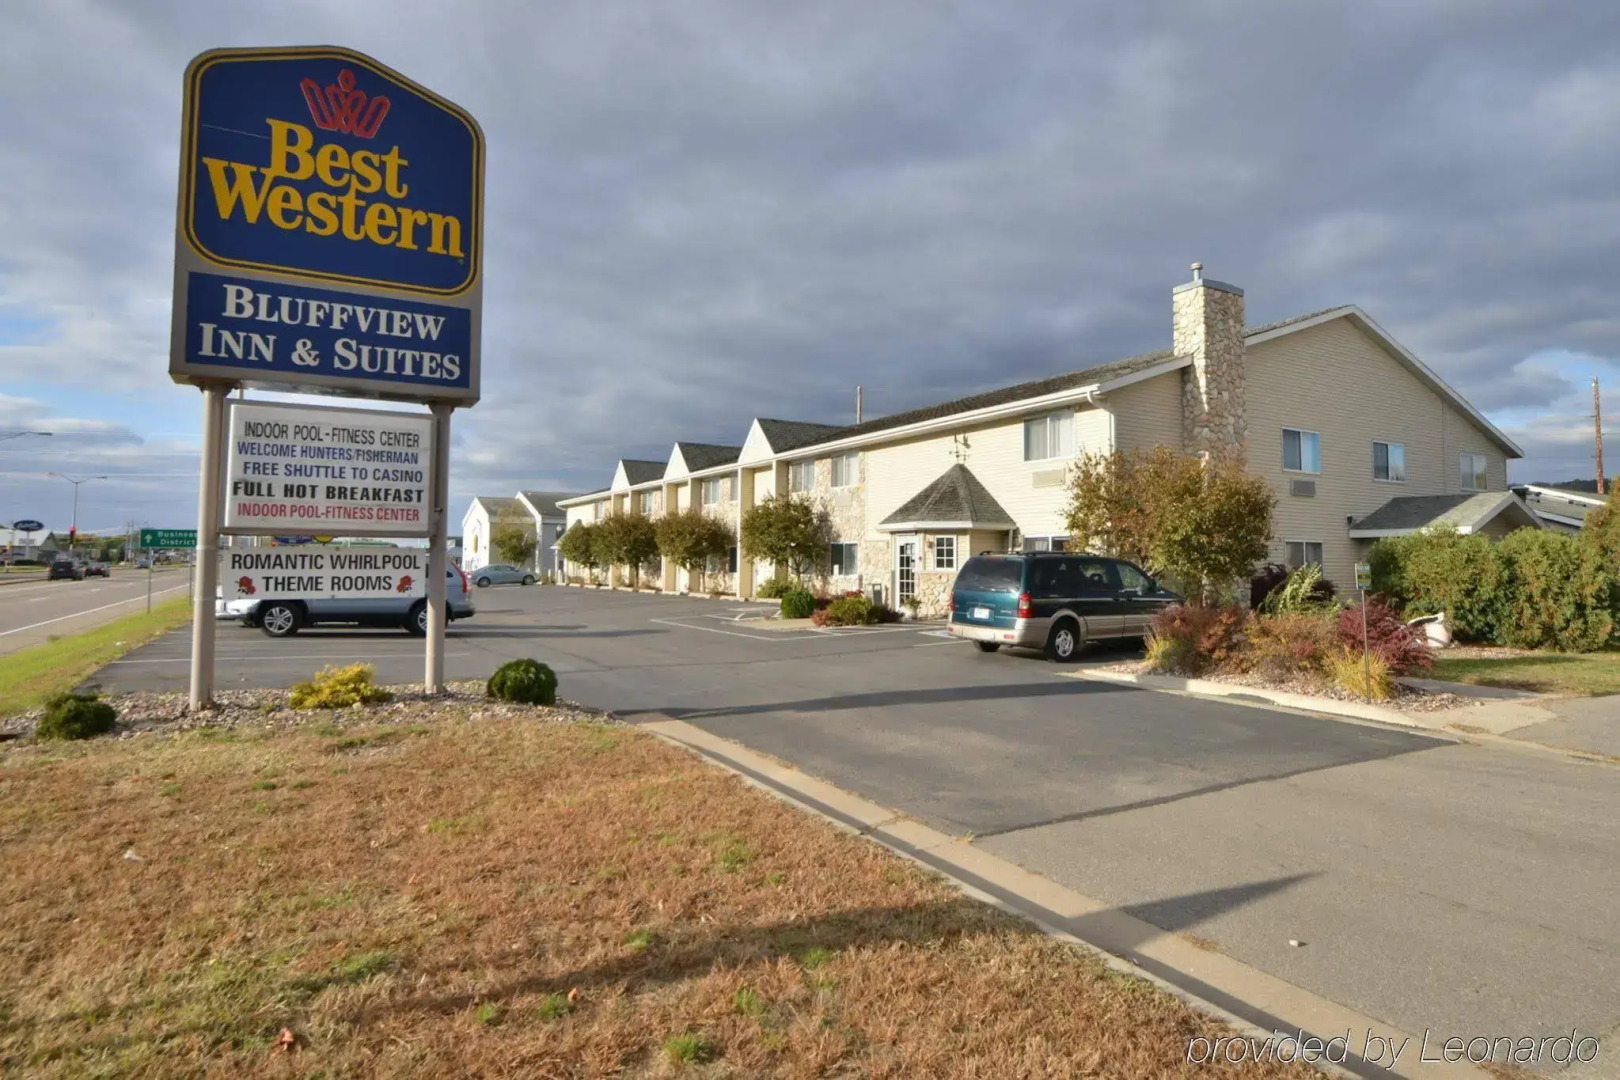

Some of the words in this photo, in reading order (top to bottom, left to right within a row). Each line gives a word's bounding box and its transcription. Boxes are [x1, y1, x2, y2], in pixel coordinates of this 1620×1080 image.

[266, 117, 408, 199] Best
[202, 156, 465, 259] Western
[222, 283, 446, 341] BLUFFVIEW
[198, 323, 277, 362] INN
[291, 338, 320, 367] &
[333, 337, 461, 381] SUITES
[244, 421, 289, 439] INDOOR
[380, 430, 420, 448] CENTER
[237, 441, 297, 459] WELCOME
[243, 461, 279, 476] FREE
[284, 463, 346, 480] SHUTTLE
[351, 467, 368, 480] TO
[373, 468, 423, 483] CASINO
[233, 481, 276, 498] FULL
[283, 483, 319, 499] HOT
[325, 485, 424, 503] BREAKFAST
[237, 502, 287, 517] INDOOR
[376, 507, 420, 521] CENTER
[231, 553, 324, 570] ROMANTIC
[330, 554, 421, 571] WHIRLPOOL
[262, 576, 323, 592] THEME
[331, 575, 393, 591] ROOMS
